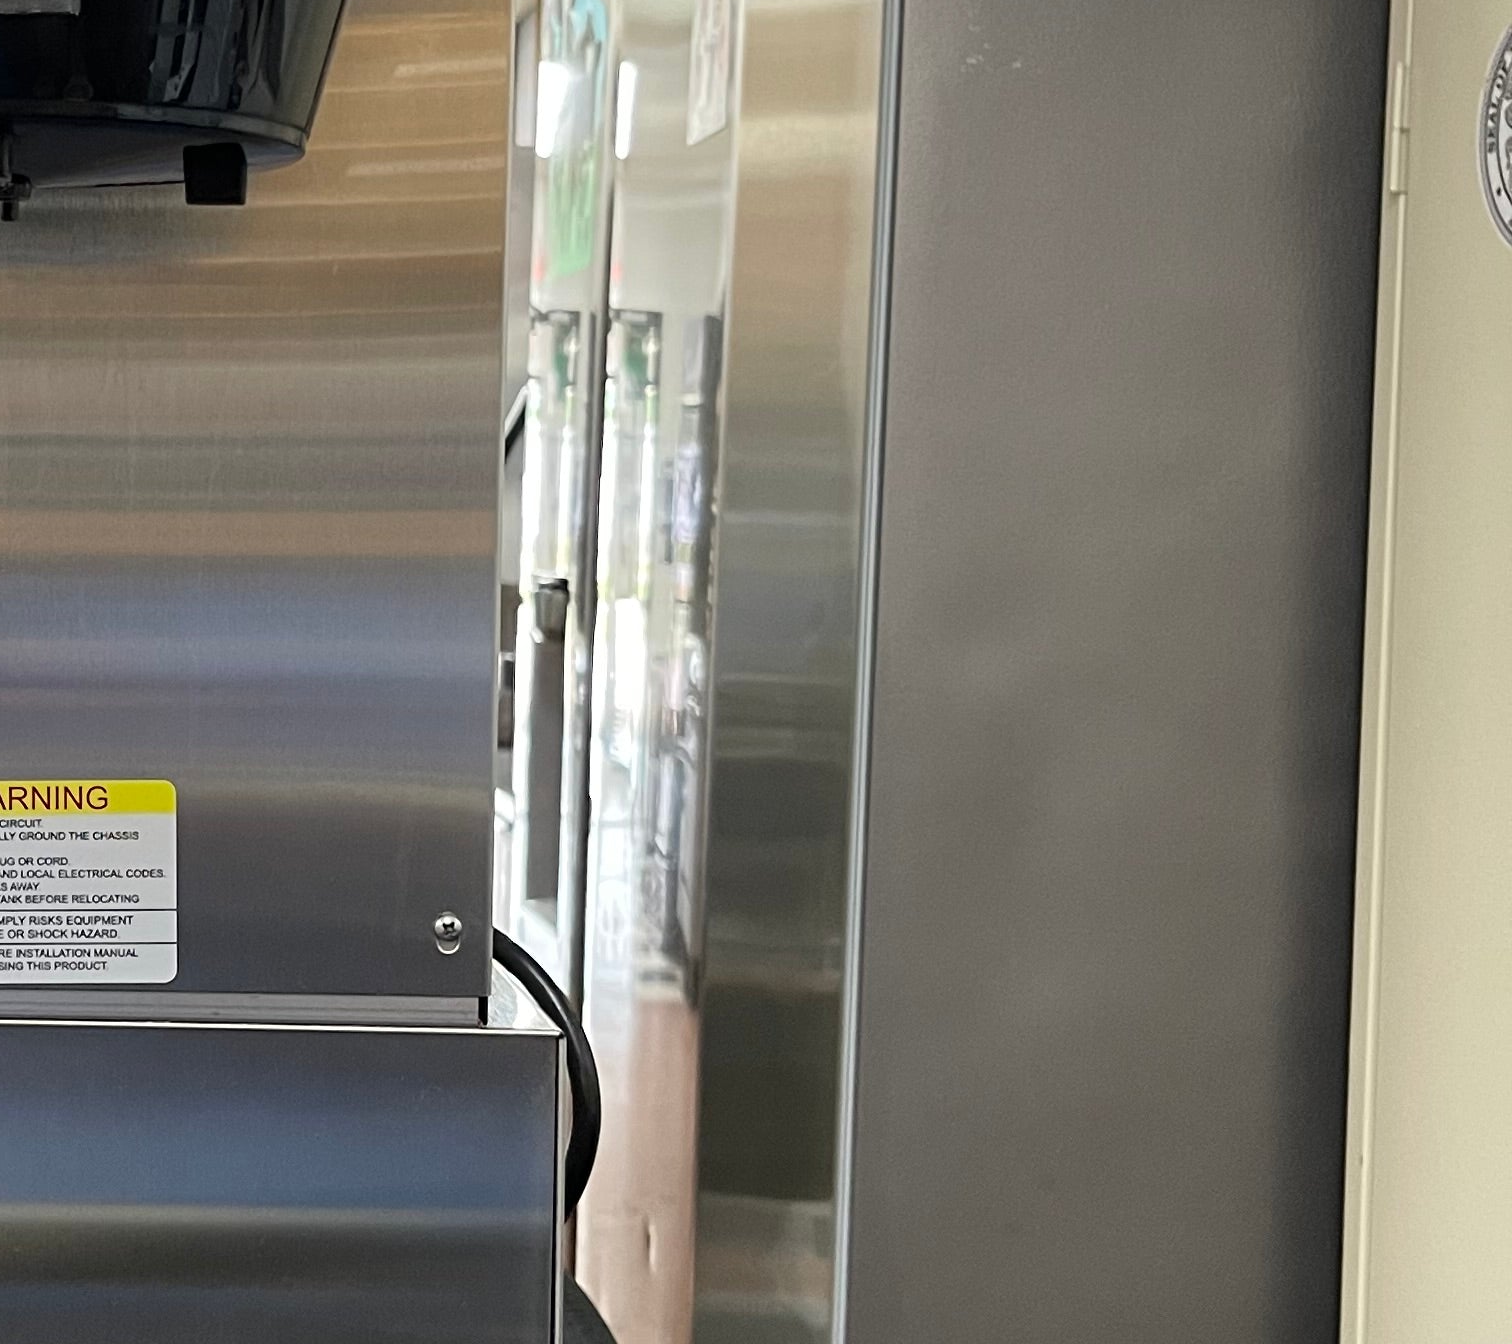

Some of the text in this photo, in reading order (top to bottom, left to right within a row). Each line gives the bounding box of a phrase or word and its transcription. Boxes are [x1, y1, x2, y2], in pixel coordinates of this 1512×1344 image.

[19, 831, 66, 841] GROUND
[69, 831, 89, 840] THE
[92, 831, 139, 840] CHASSIS
[18, 857, 34, 866] OR
[20, 869, 55, 879] LOCAL
[58, 868, 123, 879] ELECTRICAL
[25, 894, 69, 904] BEFORE
[72, 894, 140, 903] RELOCATING
[29, 916, 63, 925] RISKS
[66, 915, 134, 925] EQUIPMENT
[7, 929, 24, 939] OR
[28, 929, 67, 939] SHOCK
[16, 948, 90, 958] INSTALLATION
[94, 948, 138, 957] MANUAL
[27, 961, 51, 970] THIS
